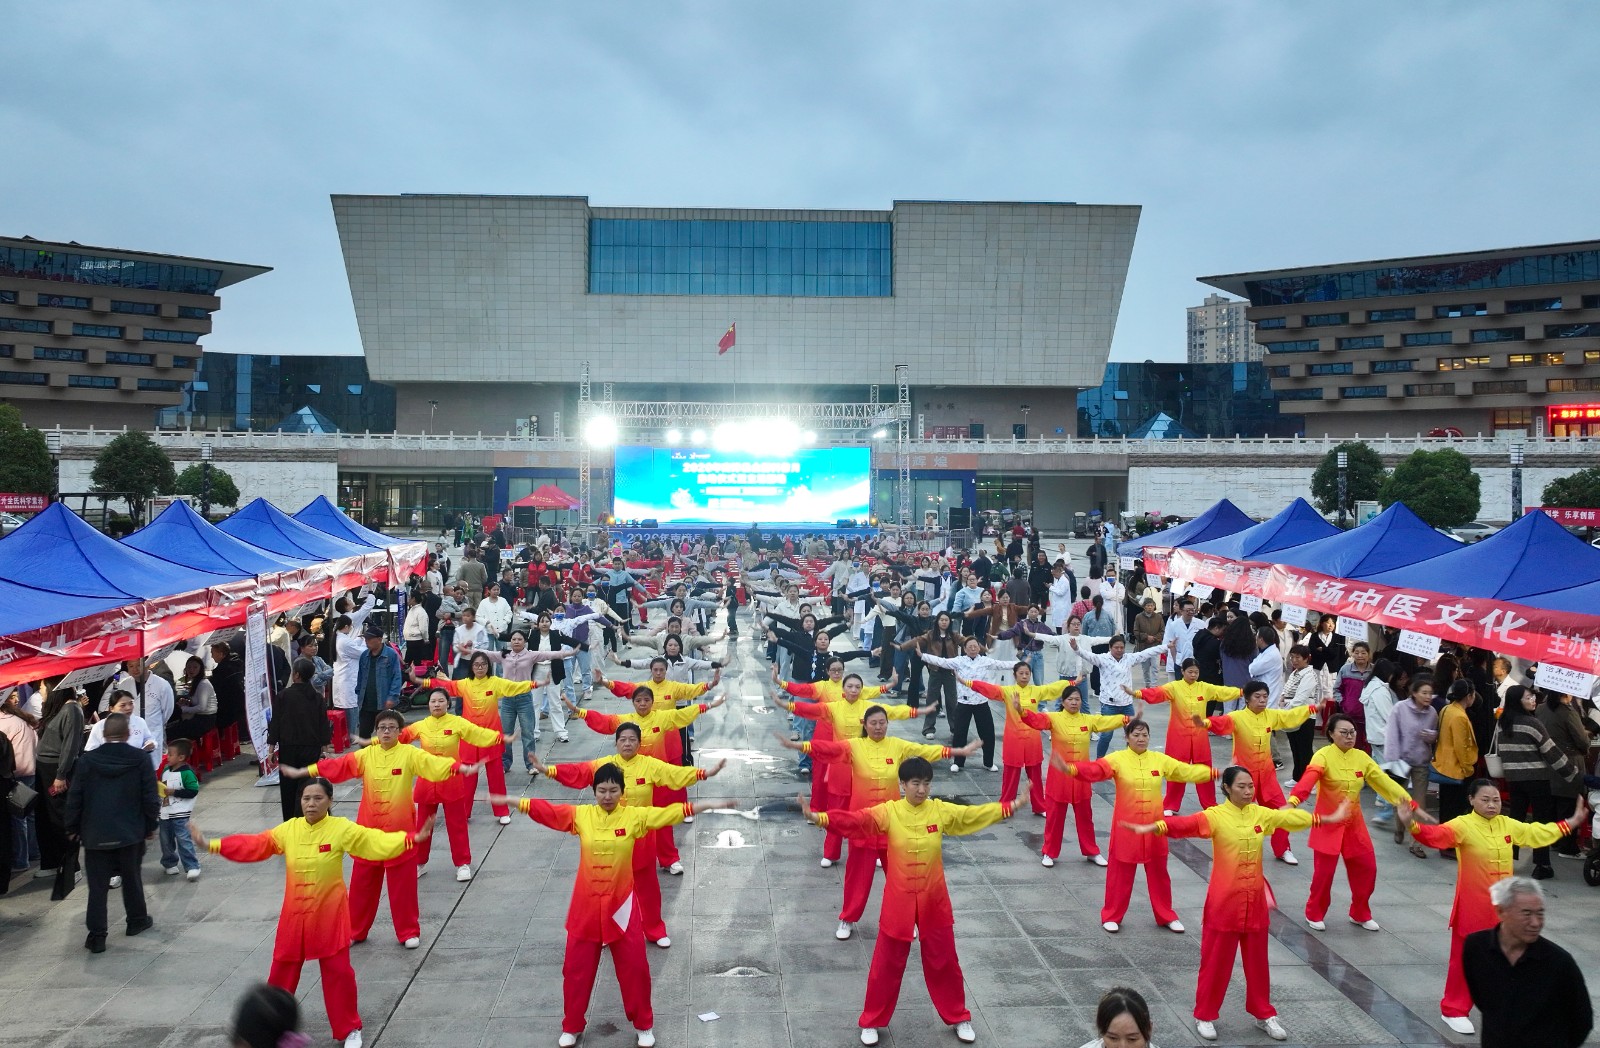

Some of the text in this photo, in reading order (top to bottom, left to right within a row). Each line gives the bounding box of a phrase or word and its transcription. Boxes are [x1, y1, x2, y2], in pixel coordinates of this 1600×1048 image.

[1564, 510, 1596, 520] 乐享创新
[1285, 574, 1528, 646] 弘扬中医文化
[1545, 665, 1585, 680] 治未病科
